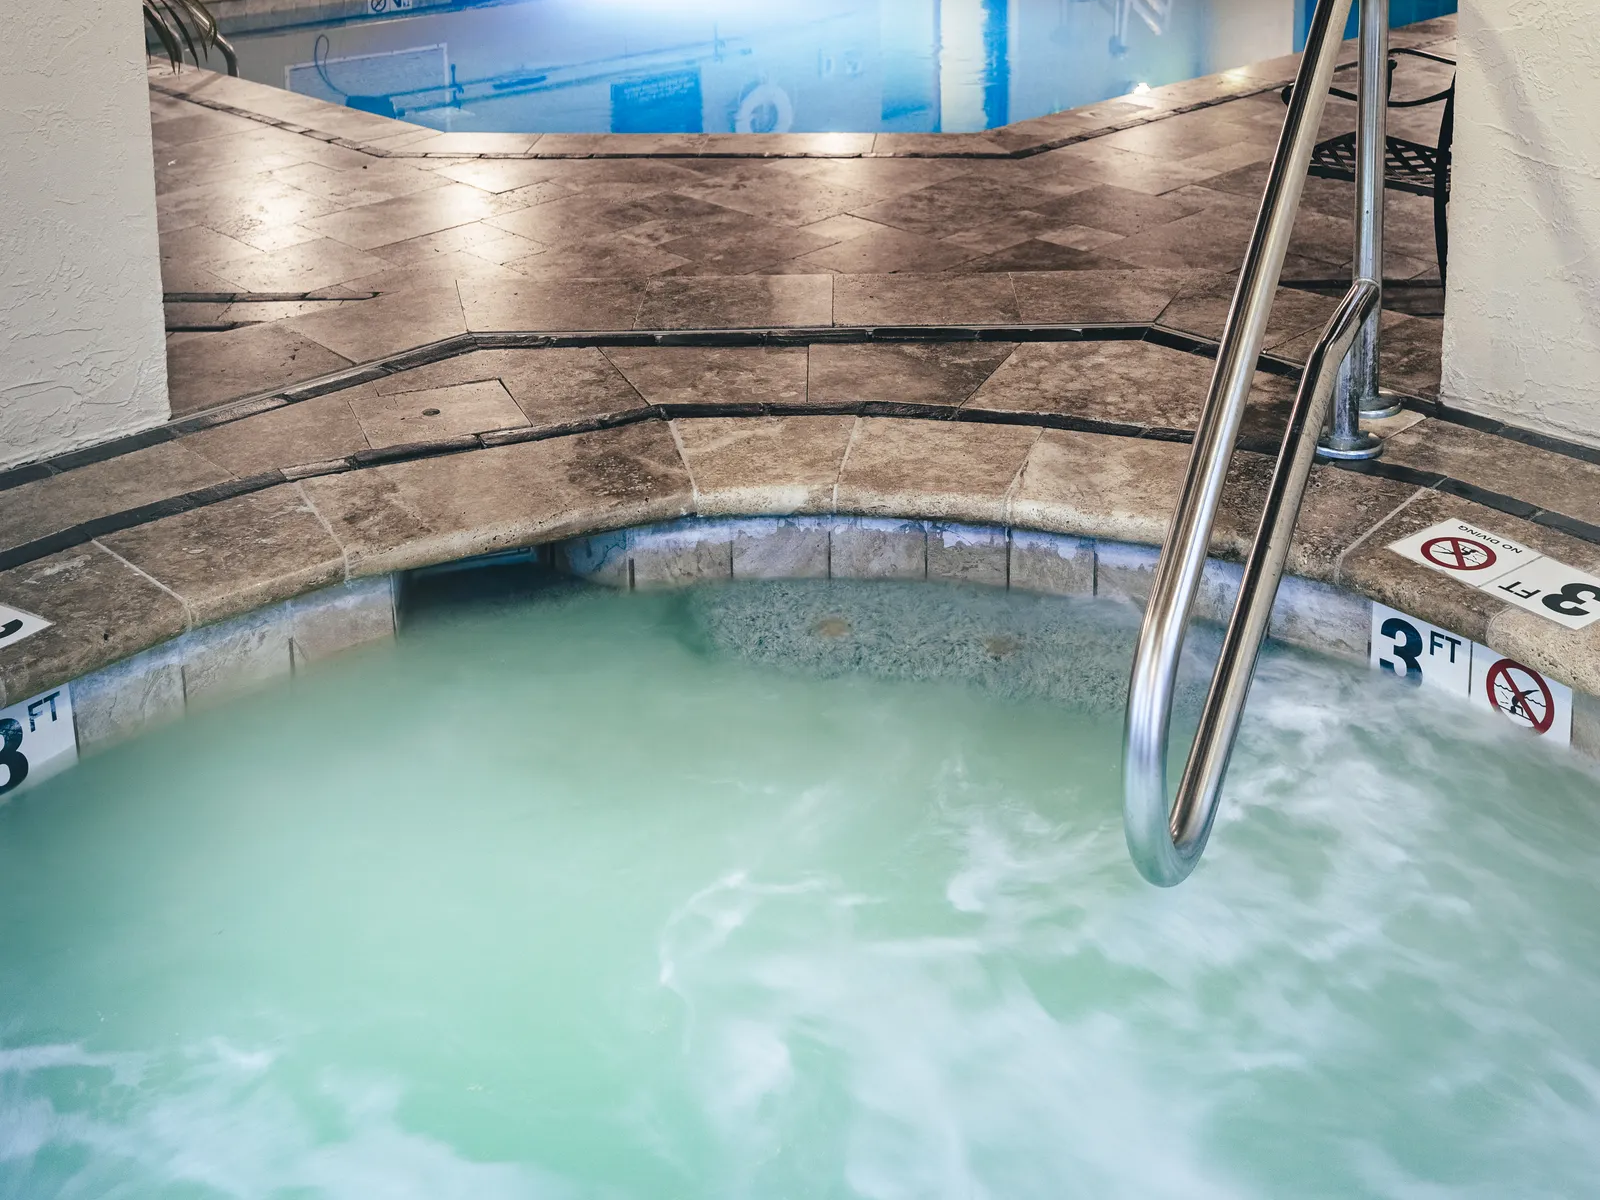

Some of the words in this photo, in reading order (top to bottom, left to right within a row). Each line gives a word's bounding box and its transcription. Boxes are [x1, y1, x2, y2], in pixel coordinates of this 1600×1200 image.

[1458, 525, 1500, 545] DIVING
[1502, 544, 1522, 554] NO
[1498, 581, 1541, 599] FT
[1542, 582, 1600, 616] 3
[1380, 618, 1423, 688] 3
[1430, 630, 1462, 664] FT
[28, 691, 60, 732] FT
